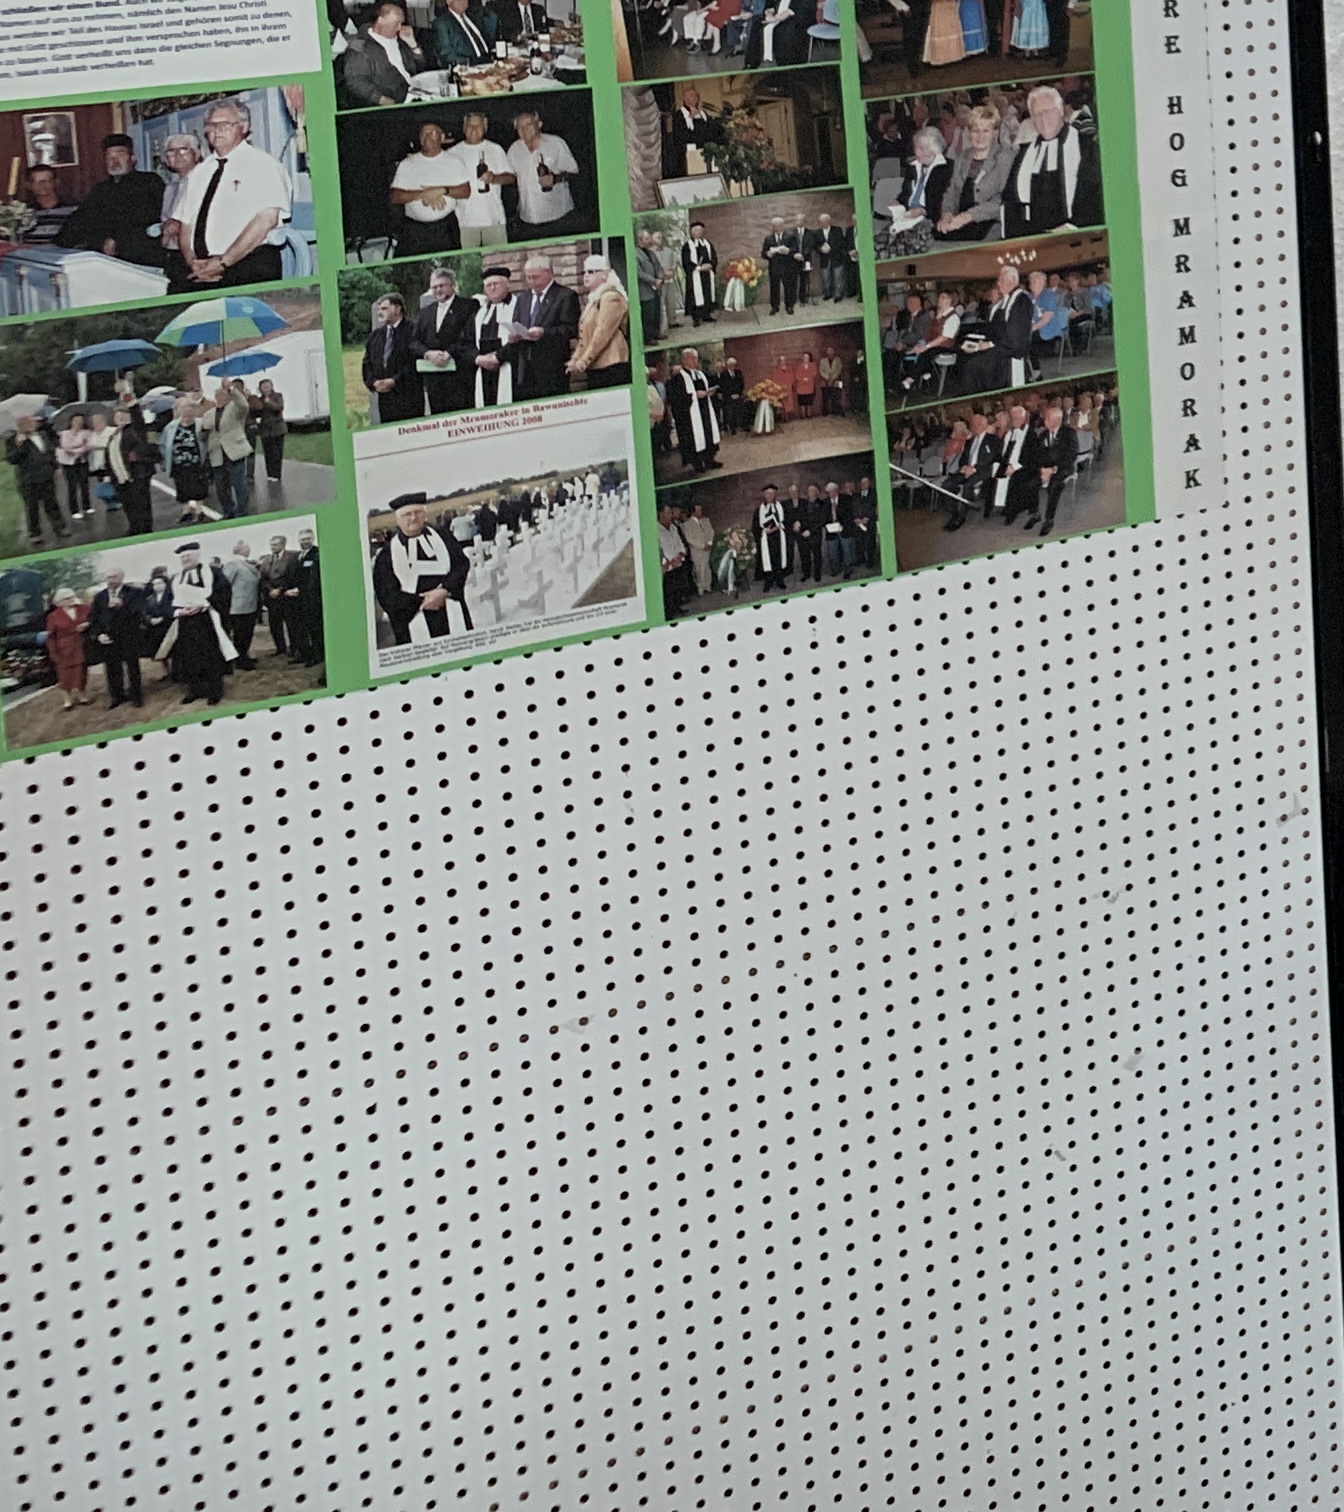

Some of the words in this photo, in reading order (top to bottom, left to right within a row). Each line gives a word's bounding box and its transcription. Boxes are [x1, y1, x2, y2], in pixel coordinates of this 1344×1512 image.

[398, 420, 439, 436] Denkmal
[460, 409, 518, 425] Mramoraker
[447, 419, 519, 438] EINWEIHUNG
